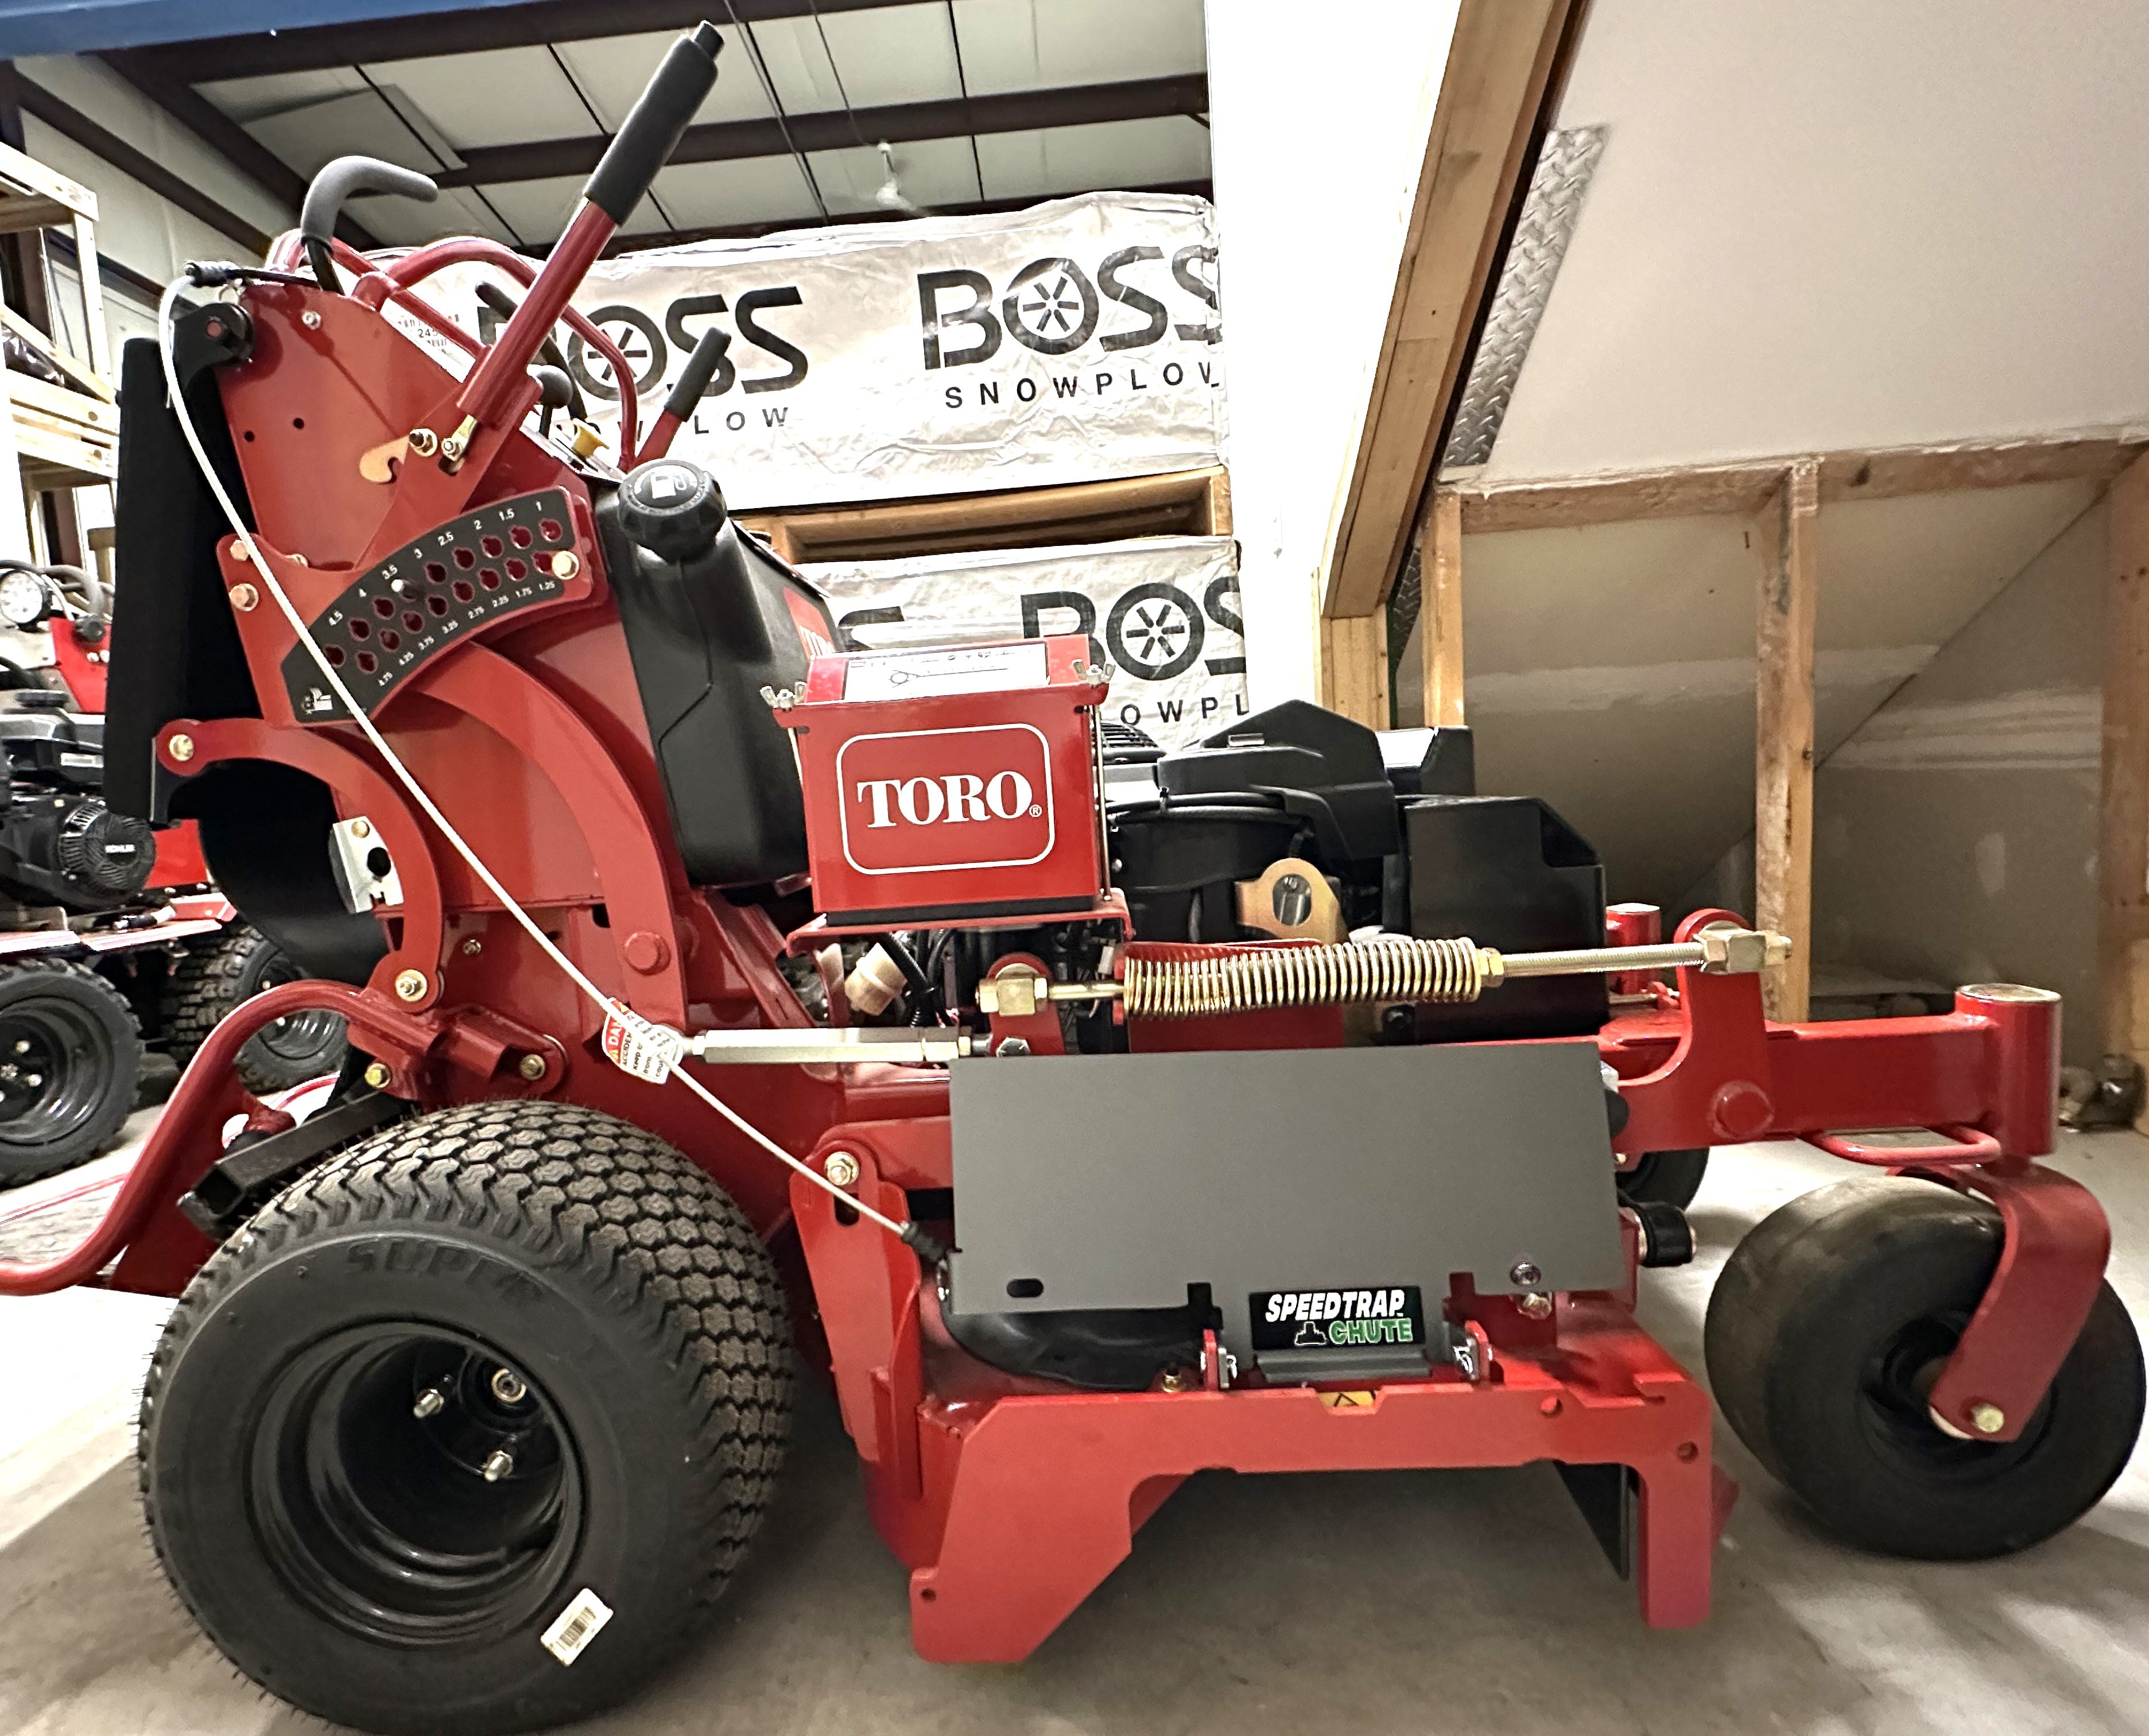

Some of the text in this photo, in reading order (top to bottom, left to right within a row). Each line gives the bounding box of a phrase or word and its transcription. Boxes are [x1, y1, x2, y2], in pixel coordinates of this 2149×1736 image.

[328, 501, 542, 626] 4.5 4 3.5 3 2.5 2 1.5 1
[515, 587, 533, 598] 1.75
[1021, 576, 1247, 681] BOS
[1265, 1289, 1405, 1322] SPEEDTRAP
[1328, 1318, 1414, 1346] CHUTE
